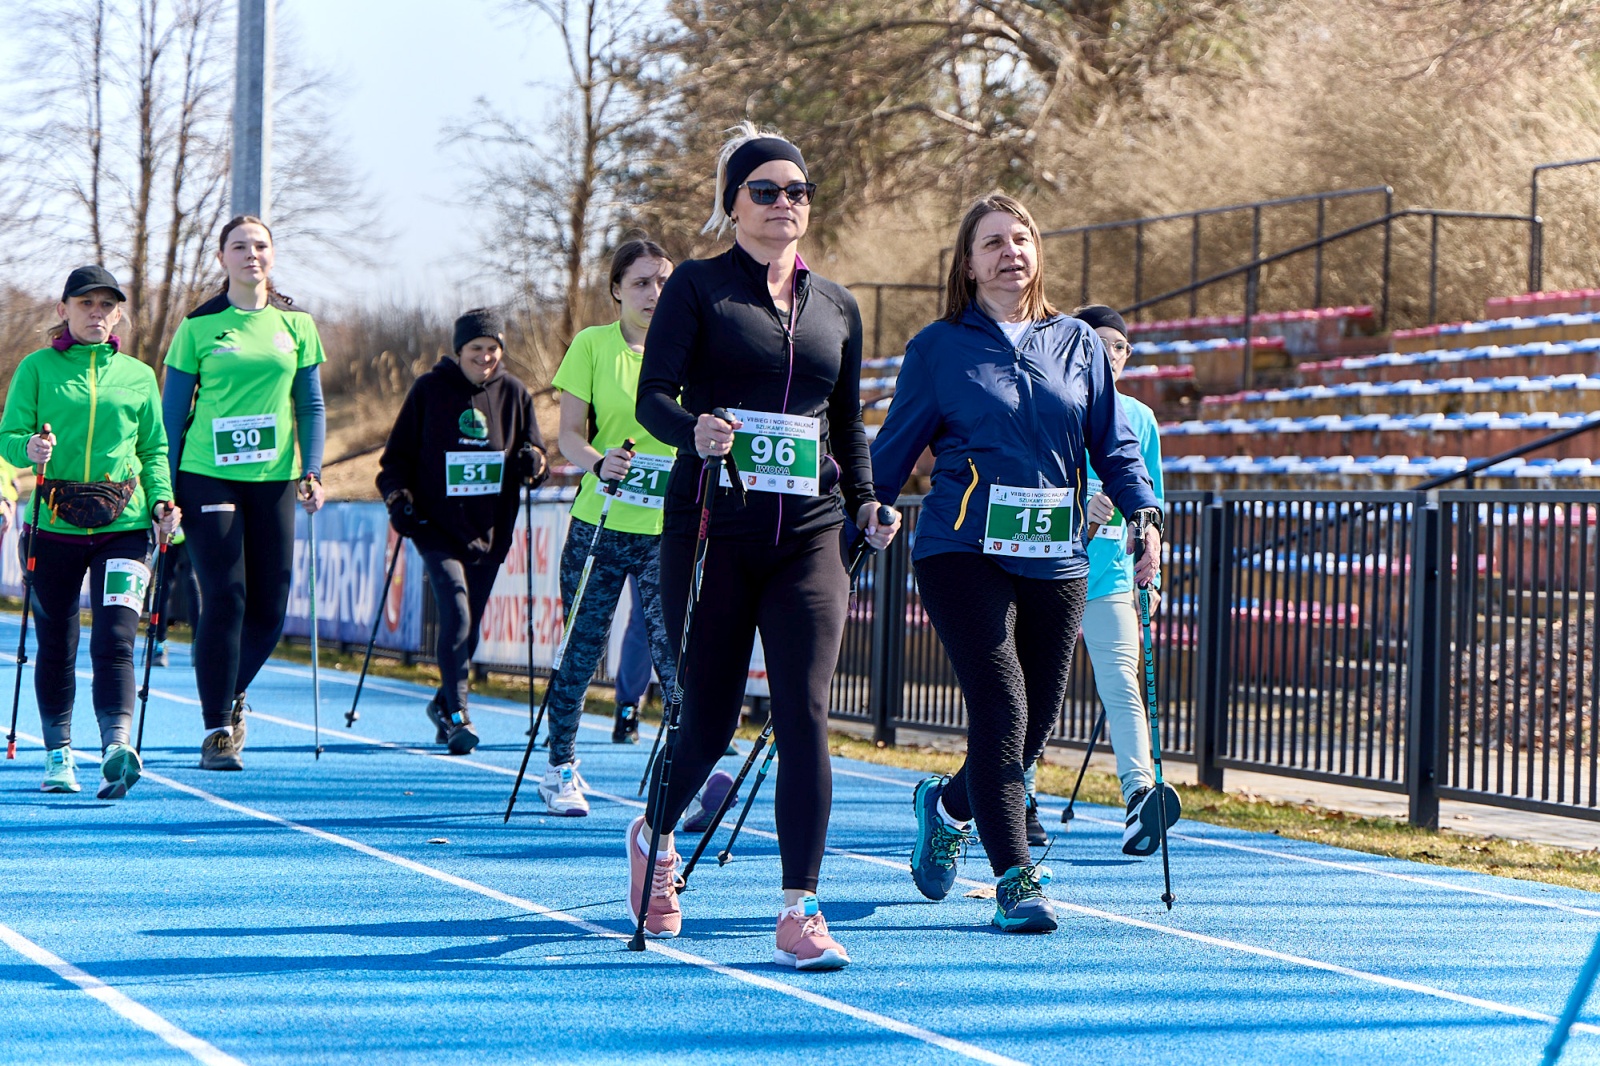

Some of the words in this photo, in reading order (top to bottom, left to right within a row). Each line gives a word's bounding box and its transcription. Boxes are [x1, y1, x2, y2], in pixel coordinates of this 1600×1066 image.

[755, 424, 784, 432] SZUKAMY
[773, 419, 793, 427] NORDIC
[231, 428, 261, 448] 90
[750, 435, 796, 467] 96
[463, 464, 488, 481] 51
[755, 464, 791, 476] IWONA
[1015, 508, 1052, 534] 15
[1011, 532, 1052, 542] JOLANTA
[126, 574, 147, 600] 13
[1140, 592, 1148, 620] masters
